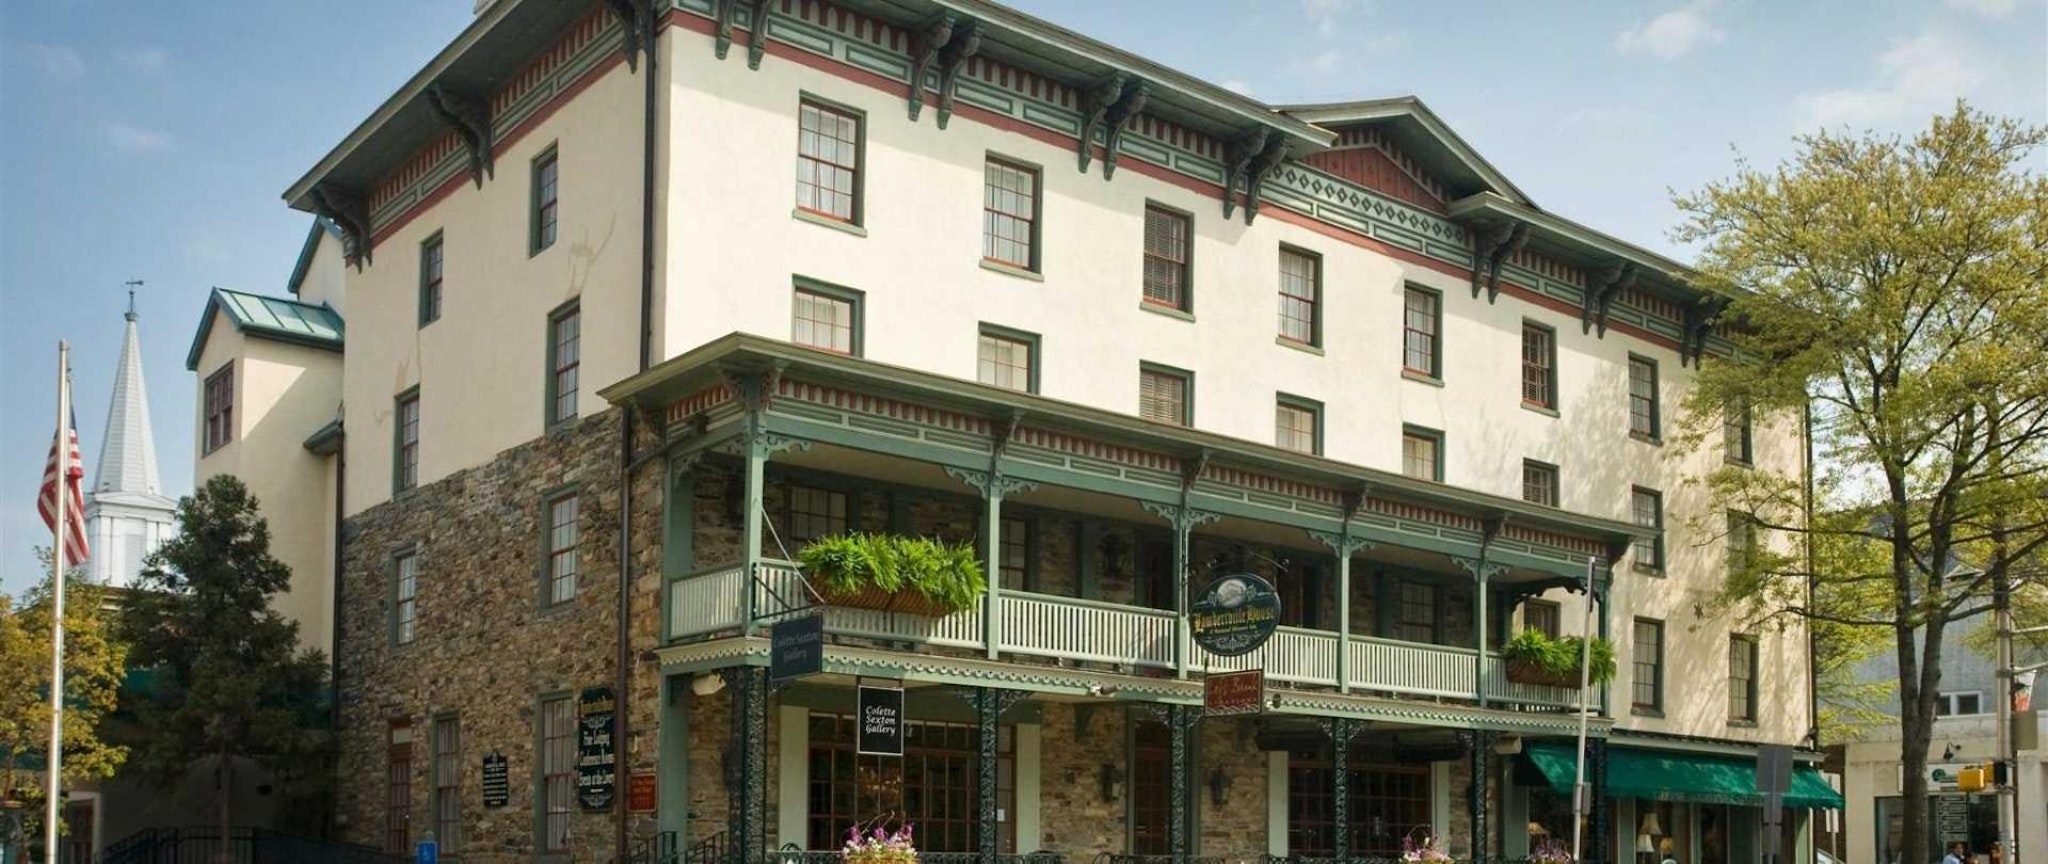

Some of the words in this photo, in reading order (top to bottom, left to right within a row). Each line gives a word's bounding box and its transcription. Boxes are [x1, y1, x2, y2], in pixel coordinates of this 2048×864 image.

[1193, 610, 1246, 633] Lambertville
[1247, 605, 1274, 623] House
[865, 705, 896, 716] Colette
[865, 715, 896, 725] Sexton
[865, 724, 896, 736] Gallery
